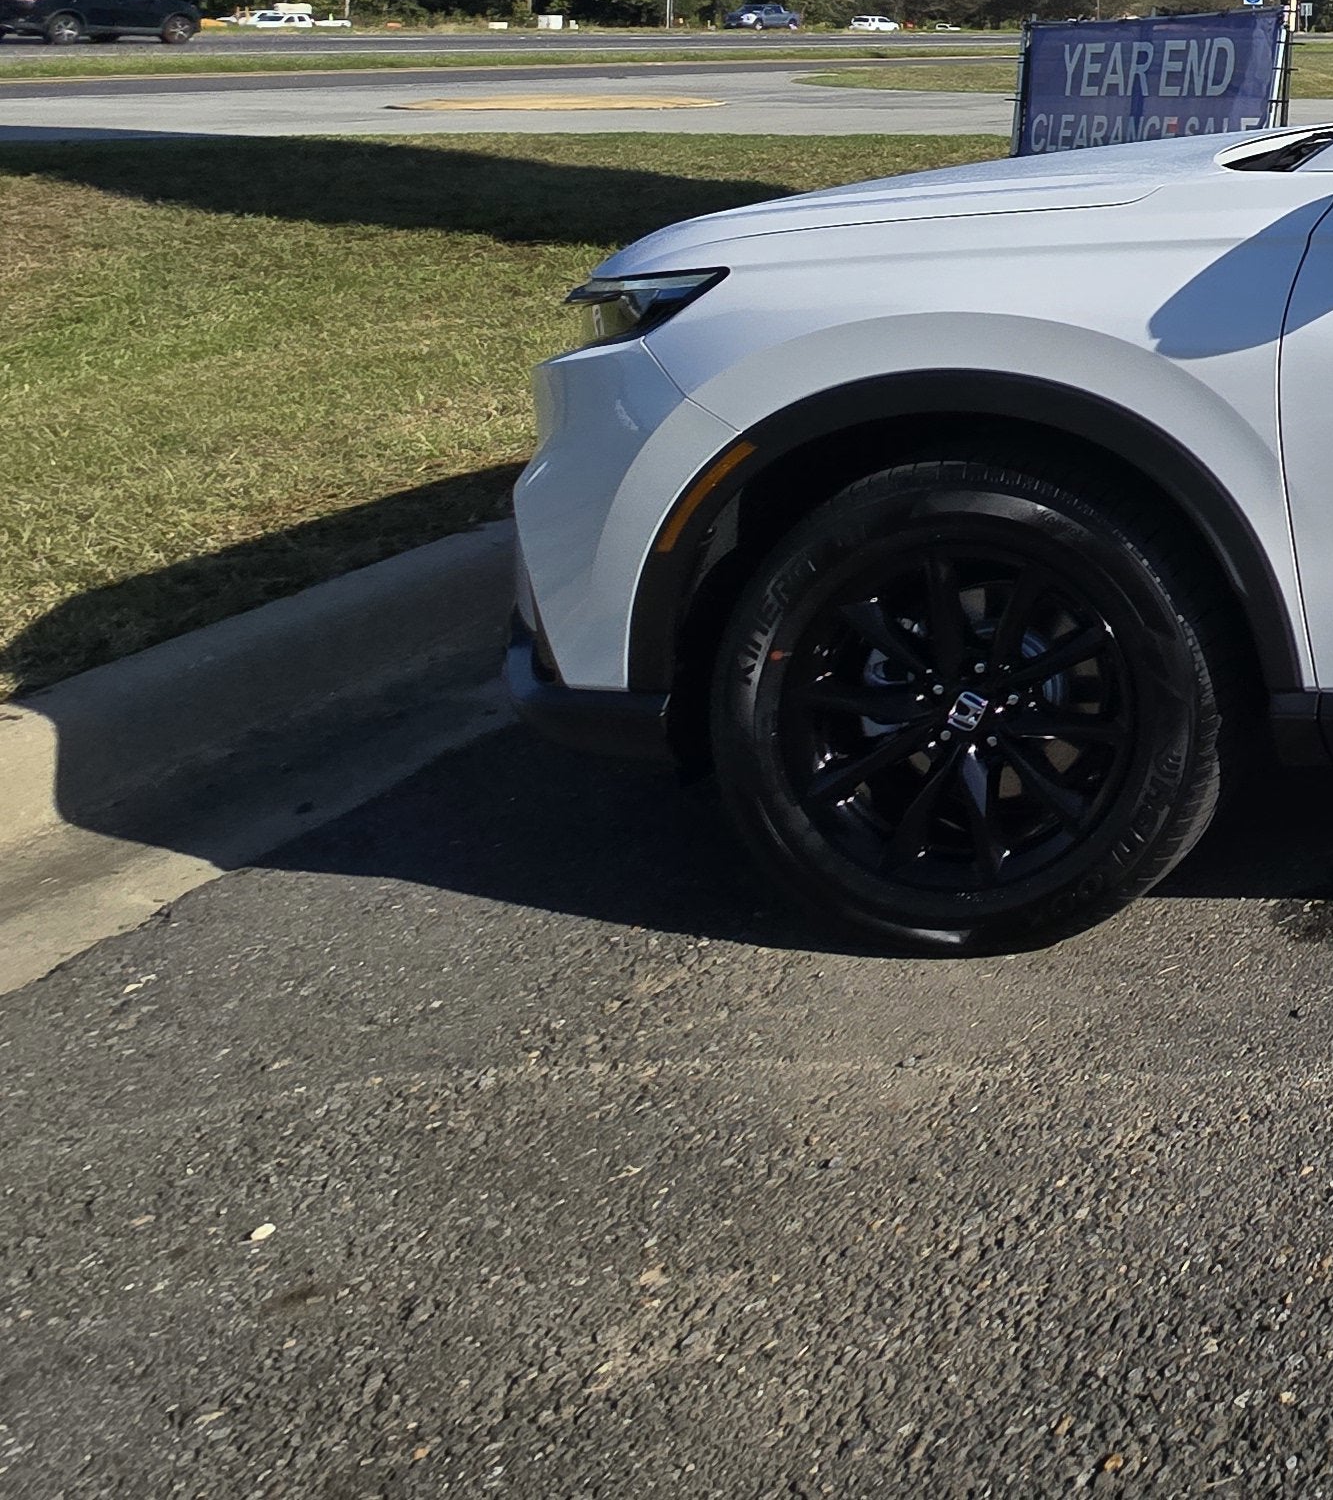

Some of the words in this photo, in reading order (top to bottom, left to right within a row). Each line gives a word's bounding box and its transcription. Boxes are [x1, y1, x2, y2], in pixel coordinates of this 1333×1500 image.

[1063, 43, 1154, 97] YEAR
[1158, 36, 1236, 97] END
[1030, 113, 1178, 151] CLEARANCE
